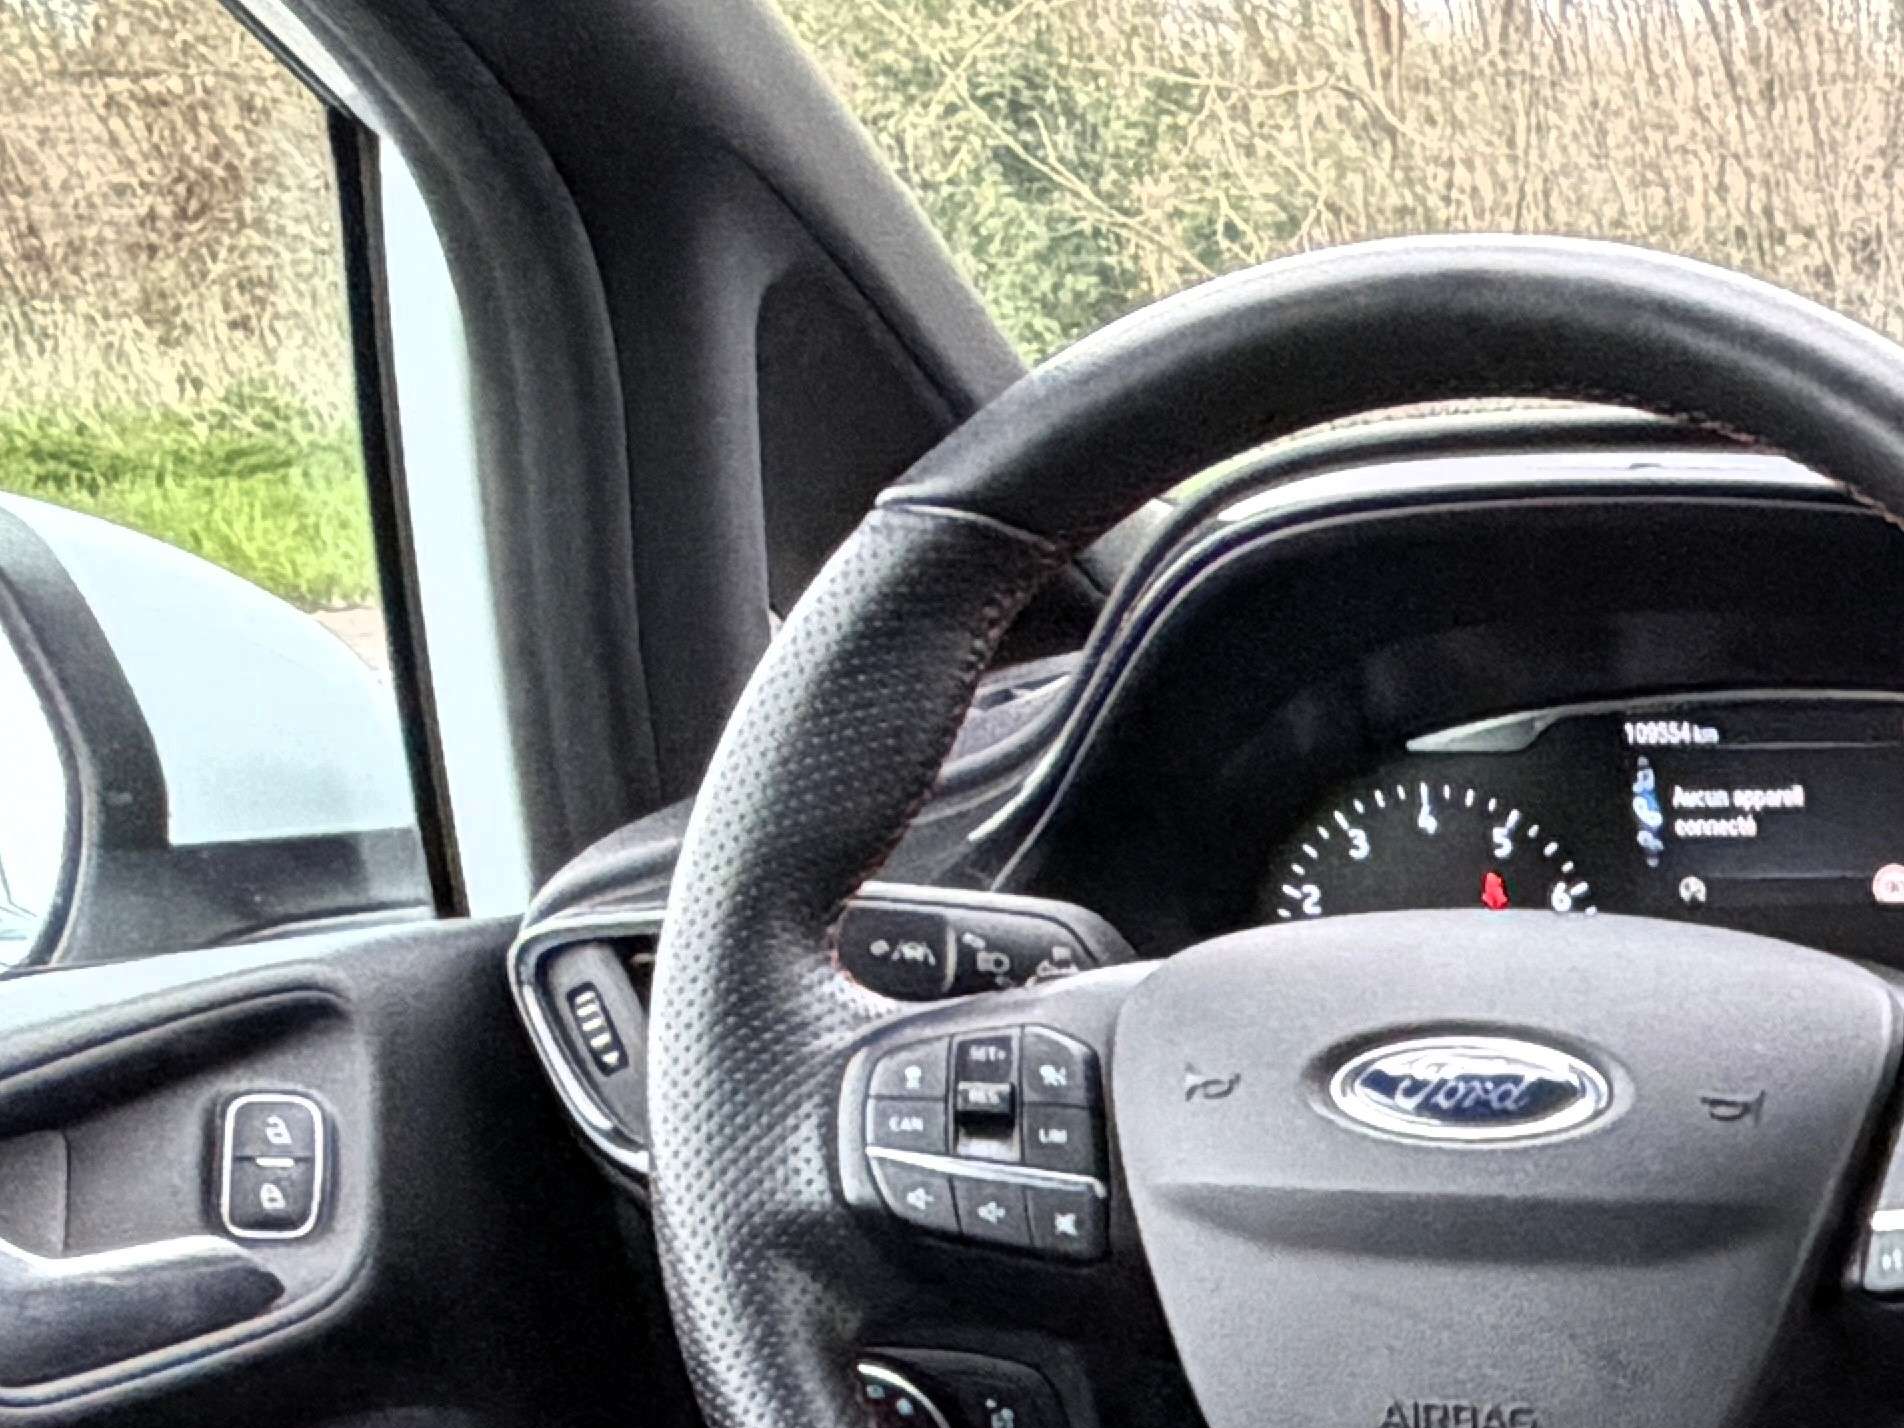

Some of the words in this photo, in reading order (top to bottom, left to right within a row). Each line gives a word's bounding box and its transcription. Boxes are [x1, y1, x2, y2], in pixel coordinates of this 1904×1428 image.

[1672, 785, 1730, 808] Aucun
[1732, 784, 1806, 812] appareil
[1348, 827, 1371, 861] 3
[1491, 825, 1513, 860] 5
[1301, 883, 1323, 915] 2
[1551, 880, 1573, 914] 6
[1393, 1055, 1530, 1115] Ford
